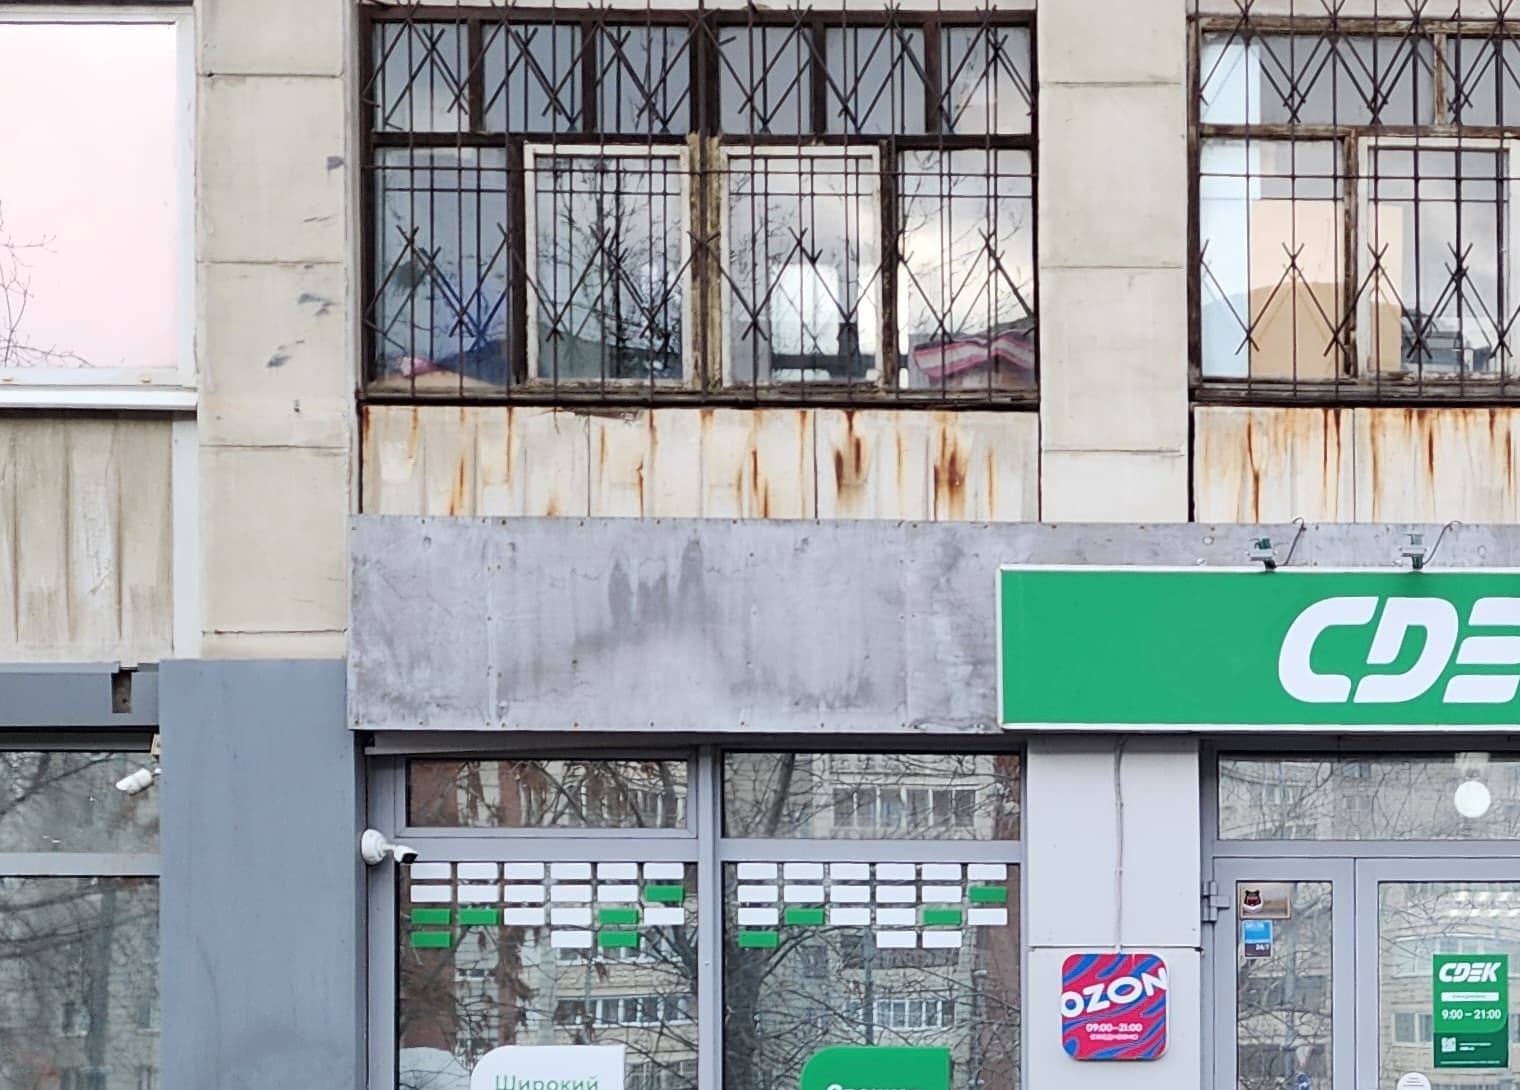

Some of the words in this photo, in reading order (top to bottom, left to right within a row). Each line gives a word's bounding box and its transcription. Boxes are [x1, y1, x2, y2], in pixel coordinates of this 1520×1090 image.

[1439, 962, 1501, 982] CDEK
[1061, 967, 1167, 1018] OZON
[1441, 1009, 1463, 1019] 9:00
[1474, 1009, 1502, 1019] 21:00
